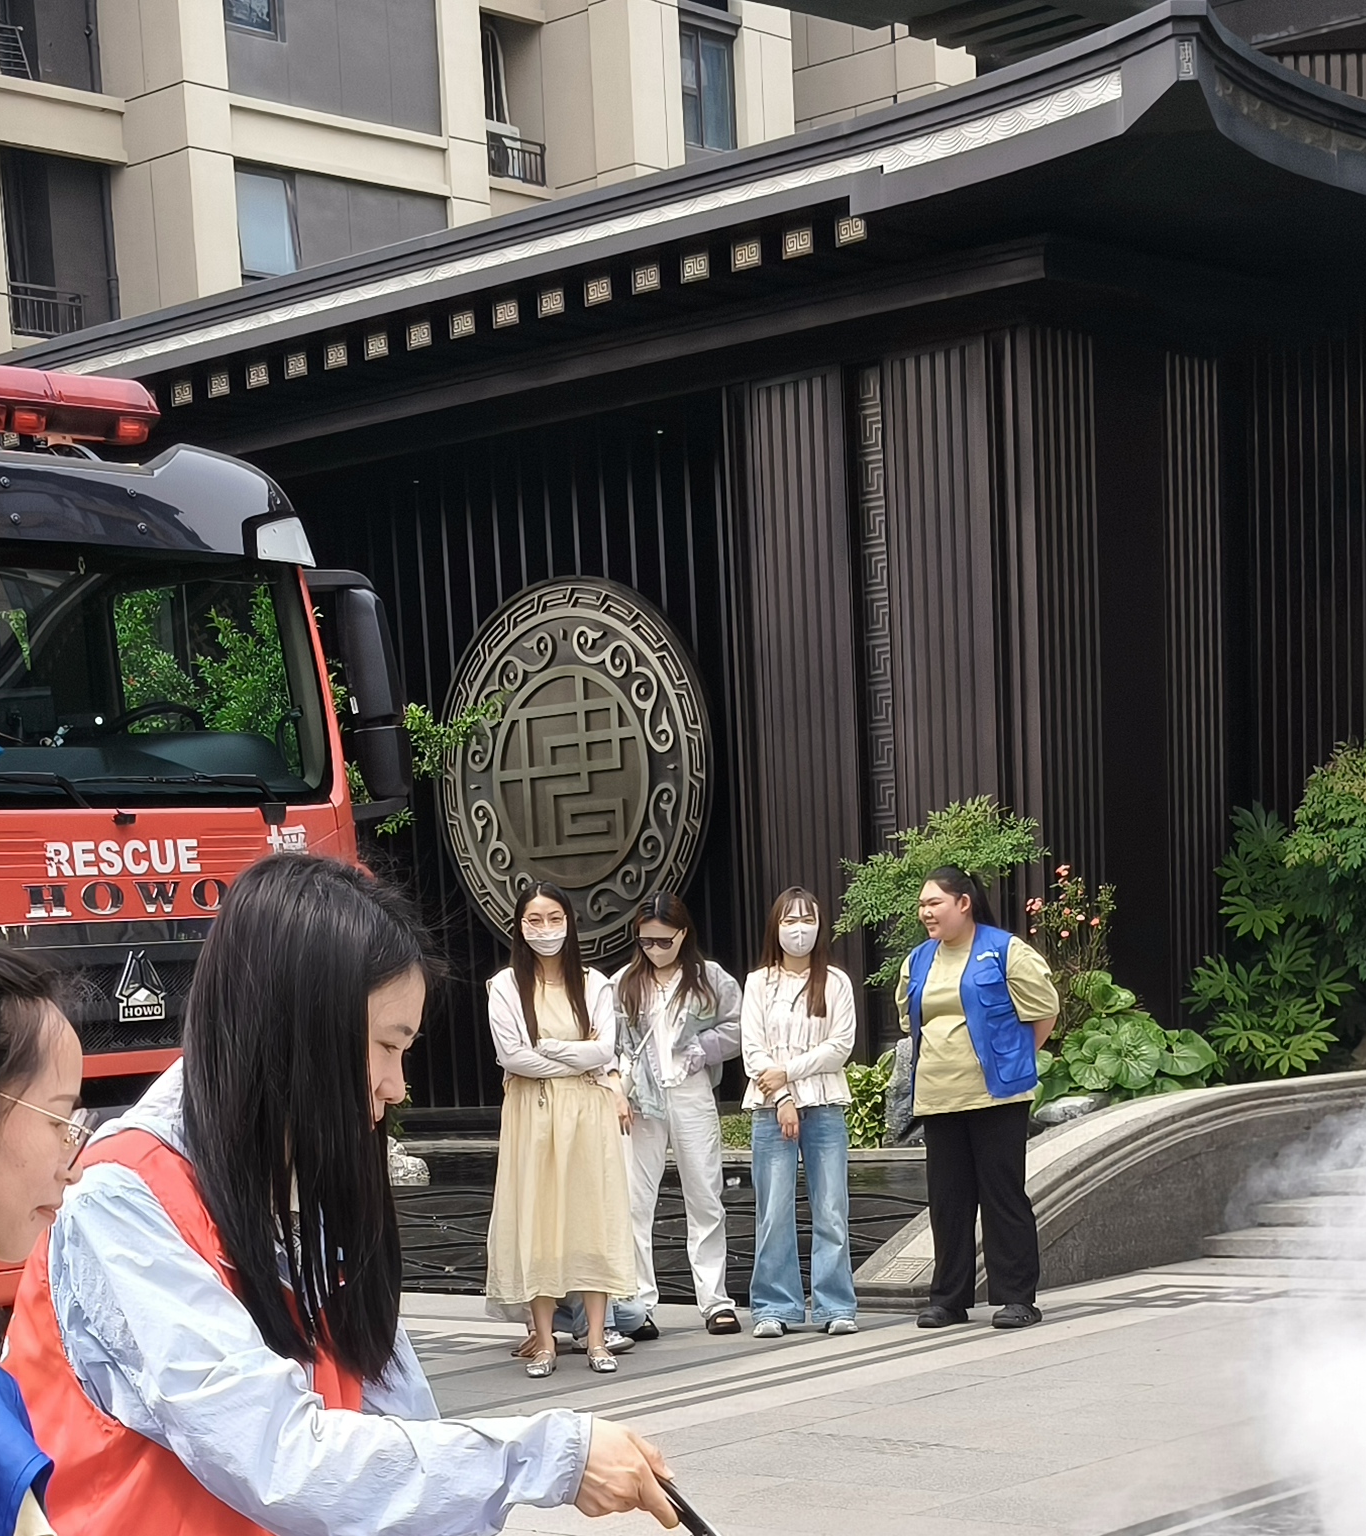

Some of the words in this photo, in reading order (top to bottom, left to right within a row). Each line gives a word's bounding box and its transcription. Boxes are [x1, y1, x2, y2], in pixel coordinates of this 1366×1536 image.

[44, 839, 201, 877] RESCUE
[22, 877, 228, 918] HOWO
[124, 1005, 162, 1017] HOWO
